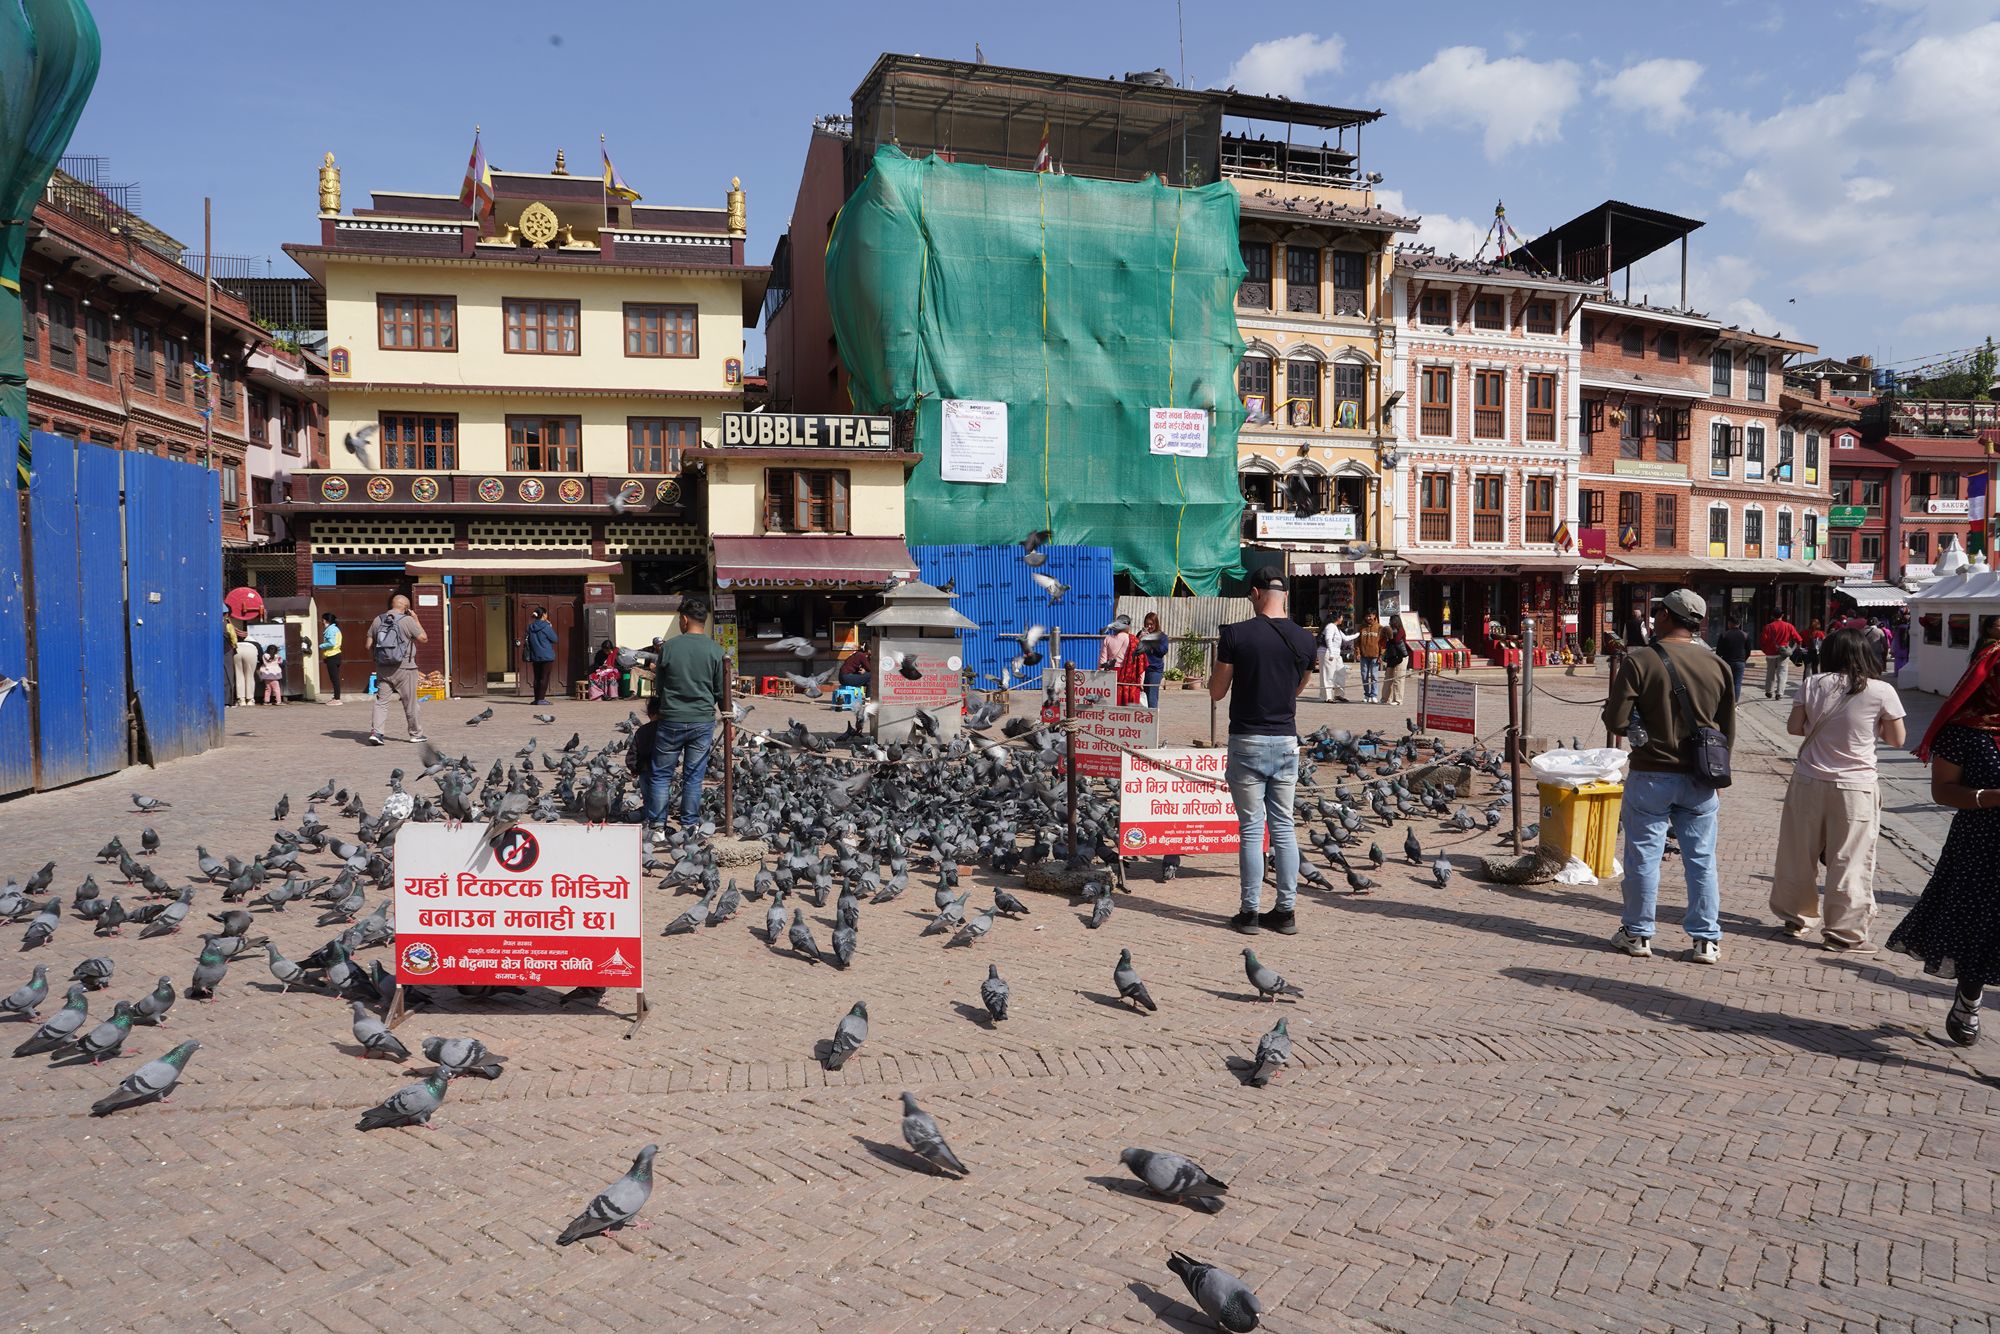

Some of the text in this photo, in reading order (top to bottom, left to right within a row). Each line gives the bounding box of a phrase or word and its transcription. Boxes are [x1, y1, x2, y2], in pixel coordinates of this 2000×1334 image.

[726, 415, 870, 447] BUBBLE TEA
[1065, 687, 1111, 698] MOKING
[1108, 712, 1131, 722] दाना
[1134, 711, 1153, 724] दिने
[1095, 724, 1115, 737] भित्र
[1118, 727, 1141, 739] प्रवेश
[1175, 755, 1193, 771] बजे
[1196, 755, 1218, 771] देखि
[1125, 777, 1143, 794] बजे
[1146, 777, 1168, 794] भित्र
[1151, 798, 1179, 815] निषेध
[1182, 798, 1223, 815] गरिएको
[1198, 834, 1219, 844] विकास
[404, 872, 630, 899] यहाँ टिकटक भिडियो
[419, 909, 496, 928] बनाउन
[504, 905, 575, 931] मनाही
[442, 956, 594, 971] श्री बौद्धनाथ क्षेत्र विकास समिति
